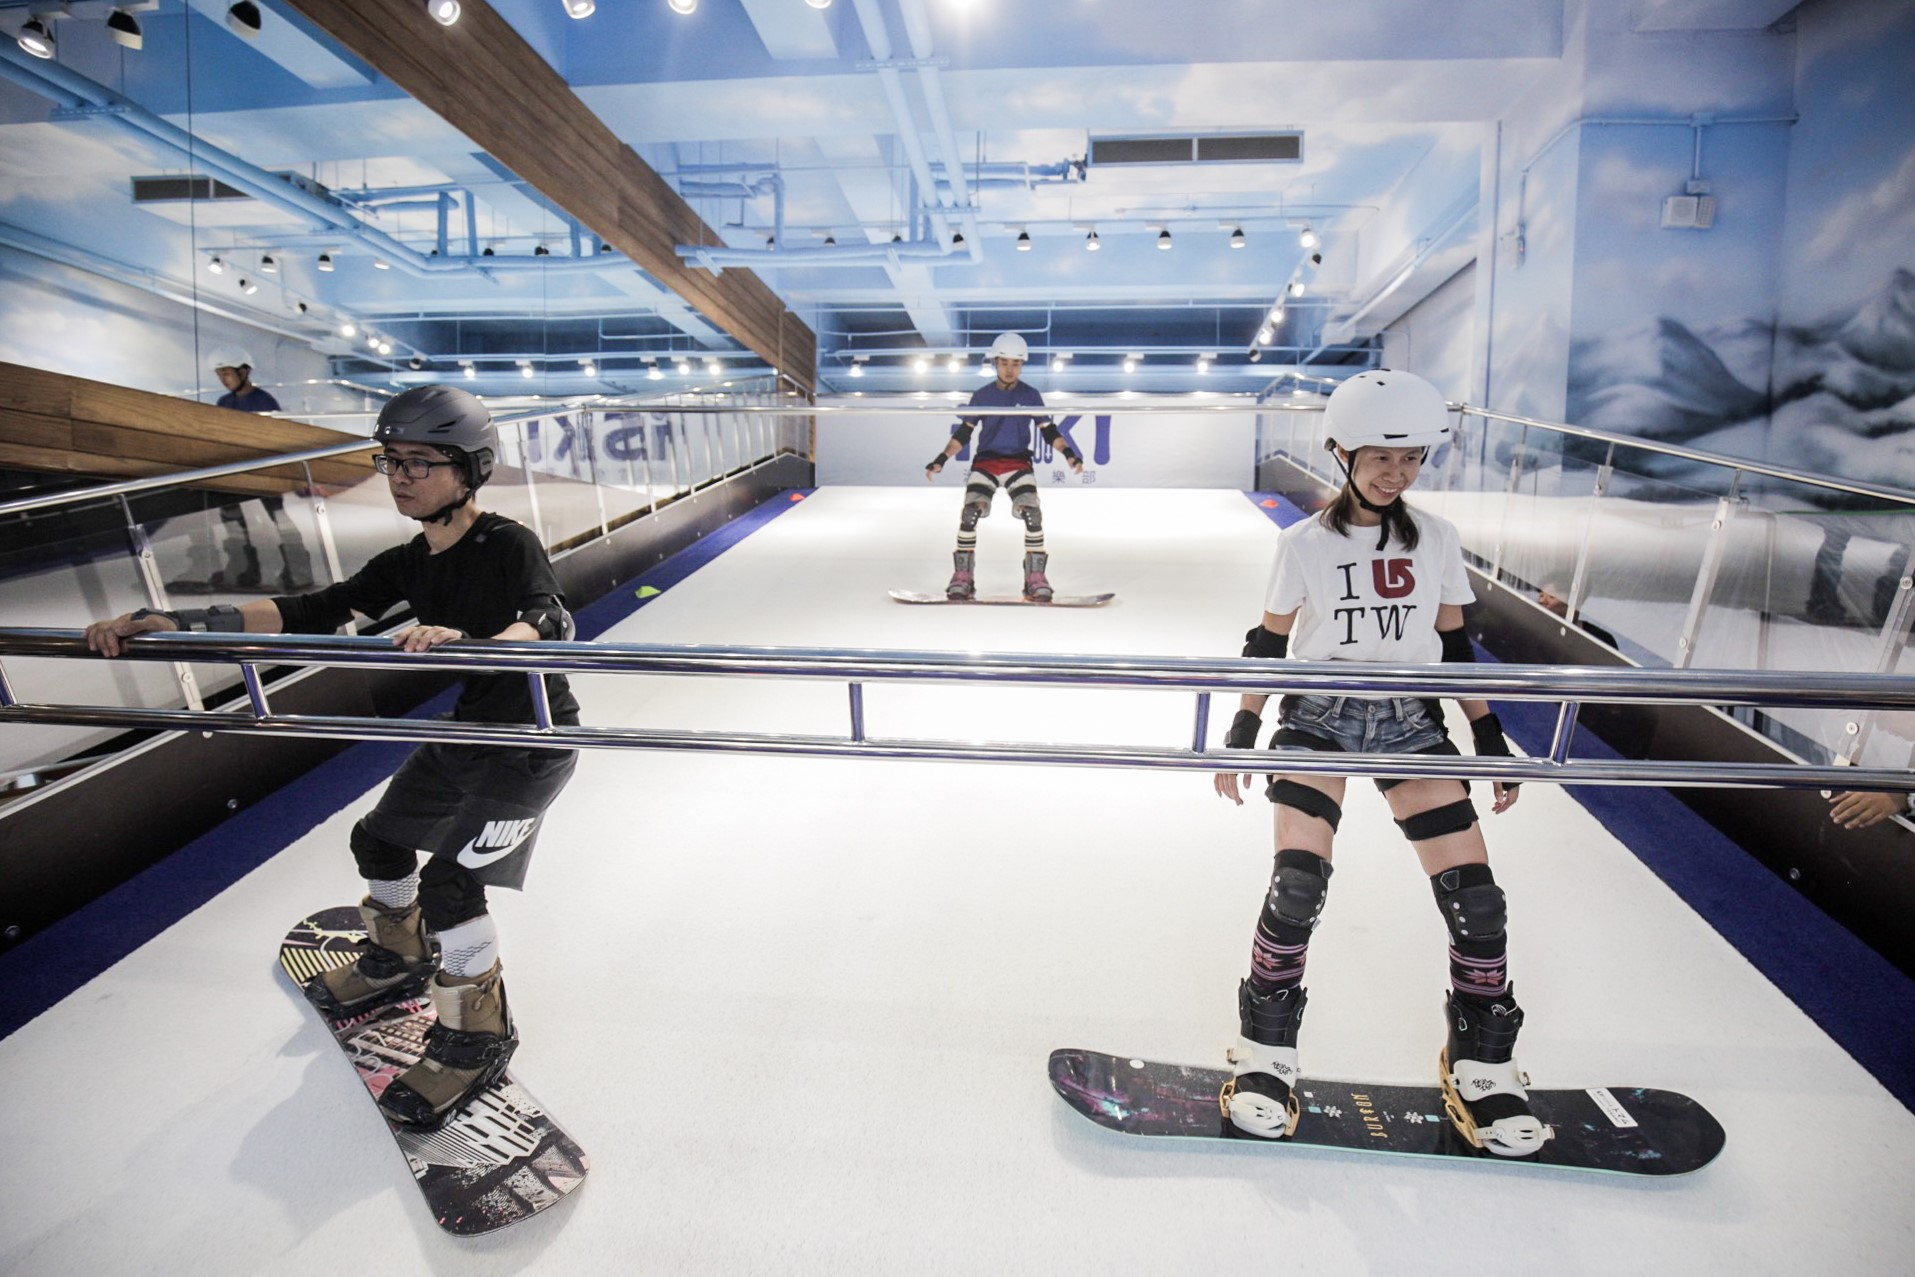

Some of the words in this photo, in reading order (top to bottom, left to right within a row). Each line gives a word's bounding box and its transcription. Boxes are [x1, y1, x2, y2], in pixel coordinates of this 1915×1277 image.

[1337, 562, 1360, 601] I
[1334, 604, 1417, 645] TW
[474, 817, 536, 848] NIKE
